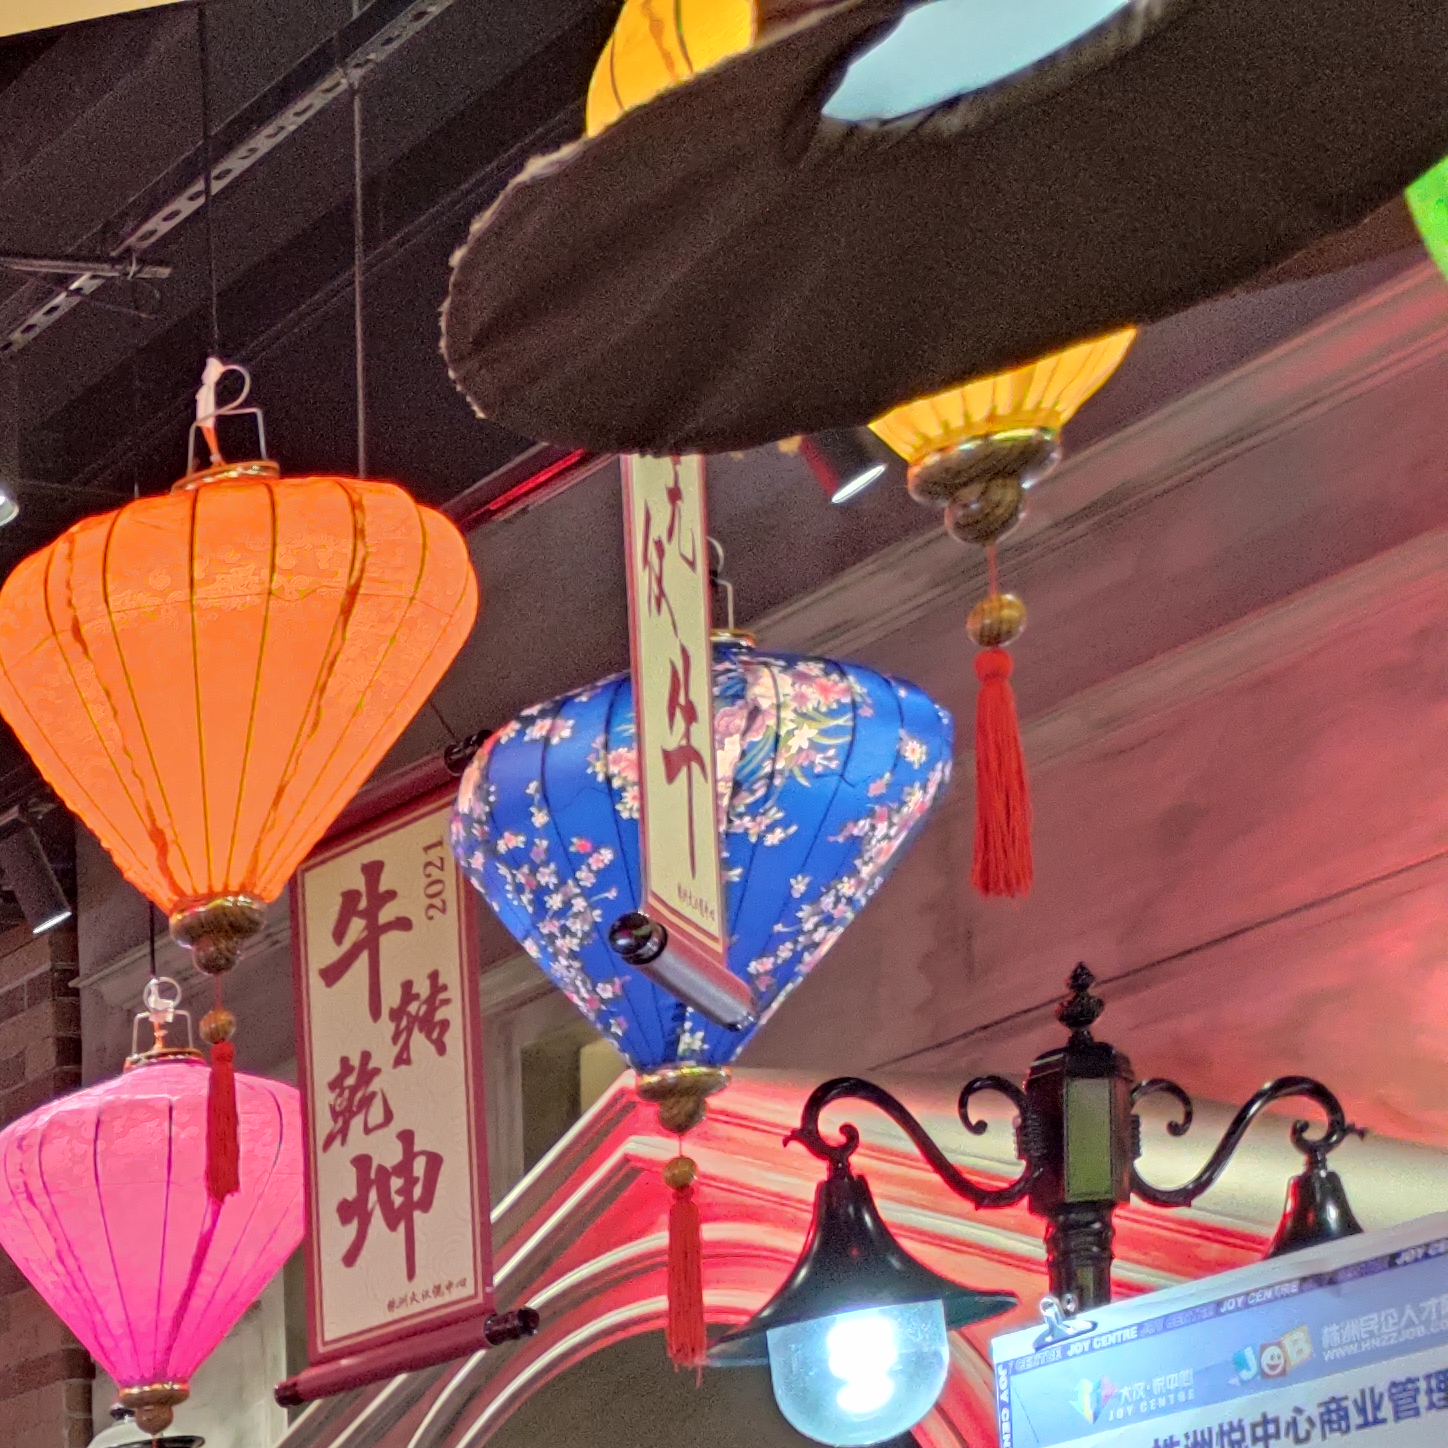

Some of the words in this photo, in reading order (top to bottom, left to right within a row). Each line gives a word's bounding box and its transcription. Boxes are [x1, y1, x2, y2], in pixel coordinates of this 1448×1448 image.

[642, 456, 709, 882] 无仅牛
[422, 837, 447, 922] 2021
[317, 859, 453, 1283] 牛转乾坤
[1395, 1248, 1423, 1267] JOY
[1219, 1295, 1247, 1314] JOY
[1247, 1279, 1300, 1307] CENTRE
[1066, 1339, 1092, 1358] JOY
[1093, 1325, 1138, 1351] CENTRE
[997, 1362, 1008, 1397] JOY
[1108, 1401, 1135, 1422] JOY
[1138, 1388, 1196, 1413] CENTRE
